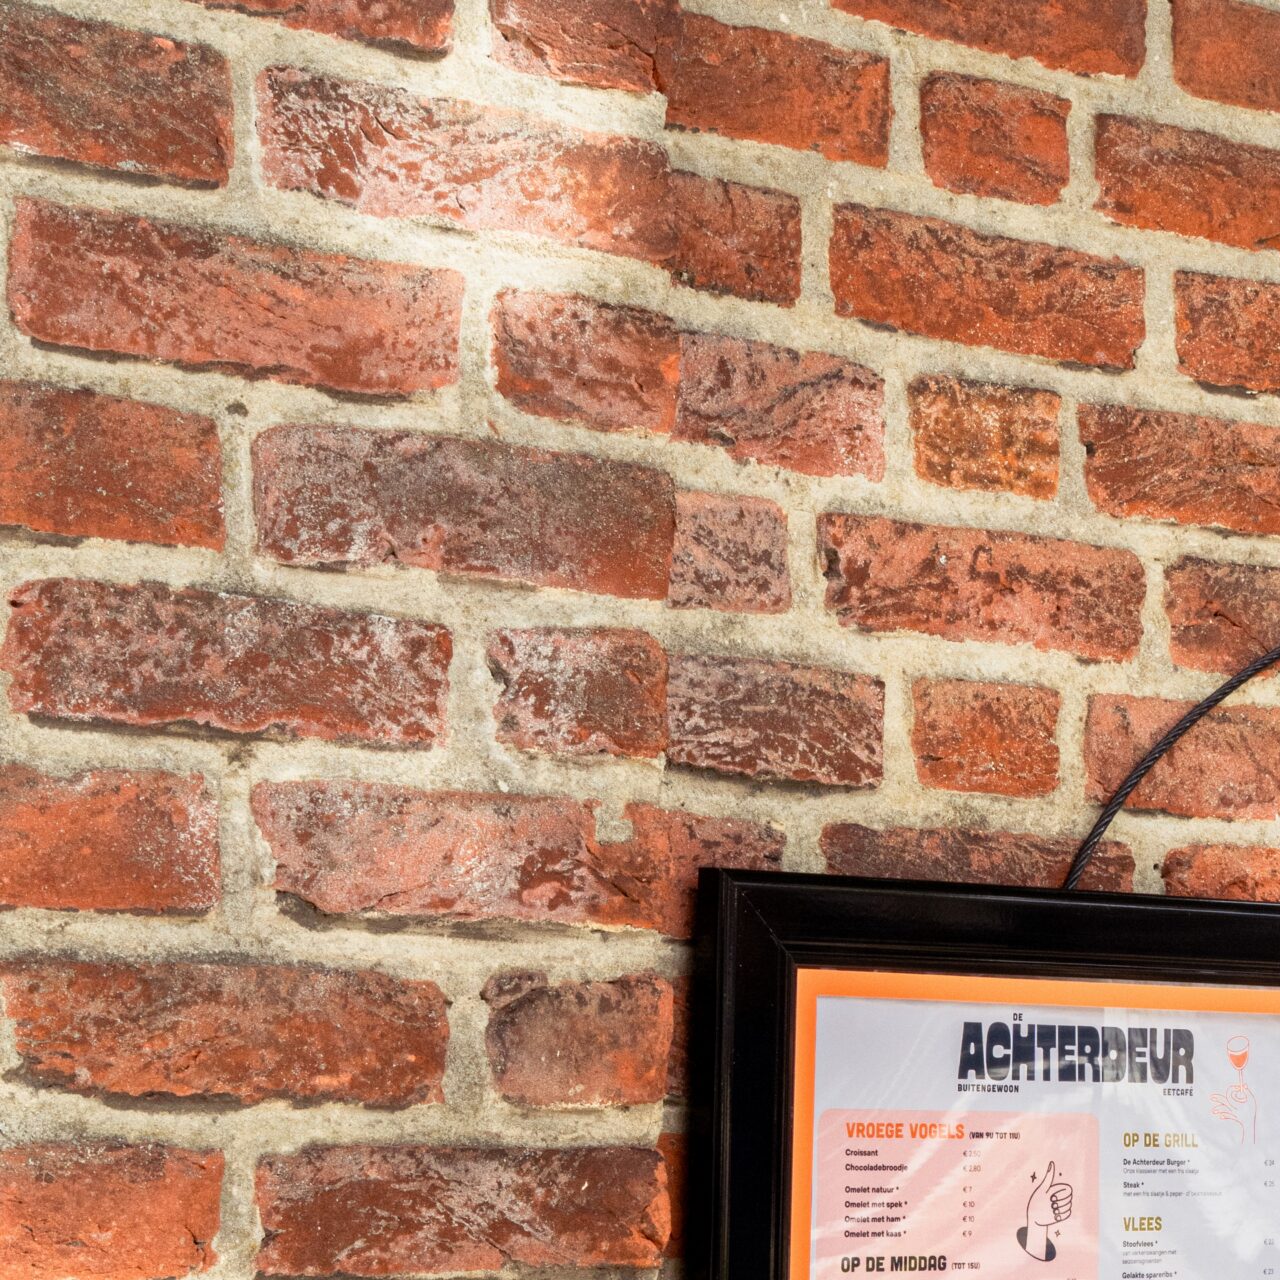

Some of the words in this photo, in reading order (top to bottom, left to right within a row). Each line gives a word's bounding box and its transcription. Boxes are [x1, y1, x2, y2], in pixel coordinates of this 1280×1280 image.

[1013, 1013, 1023, 1021] DE
[957, 1022, 1194, 1085] ACHTERDEUR
[957, 1084, 1019, 1093] BUITENGEWOON
[1162, 1086, 1194, 1096] EETCAFÉ
[846, 1122, 904, 1139] VROEGE
[910, 1123, 964, 1139] VOGELS
[1123, 1133, 1139, 1148] OP
[1144, 1133, 1159, 1147] DE
[1165, 1133, 1198, 1147] GRILL
[845, 1164, 908, 1172] Chocoladebroodje
[1167, 1159, 1186, 1167] Burger
[886, 1201, 903, 1209] spek
[1123, 1216, 1162, 1231] VLEES
[841, 1256, 860, 1273] OP
[866, 1257, 885, 1272] DE
[890, 1255, 947, 1271] MIDDAG
[951, 1262, 965, 1270] (TOT
[1146, 1271, 1172, 1279] spareribs
